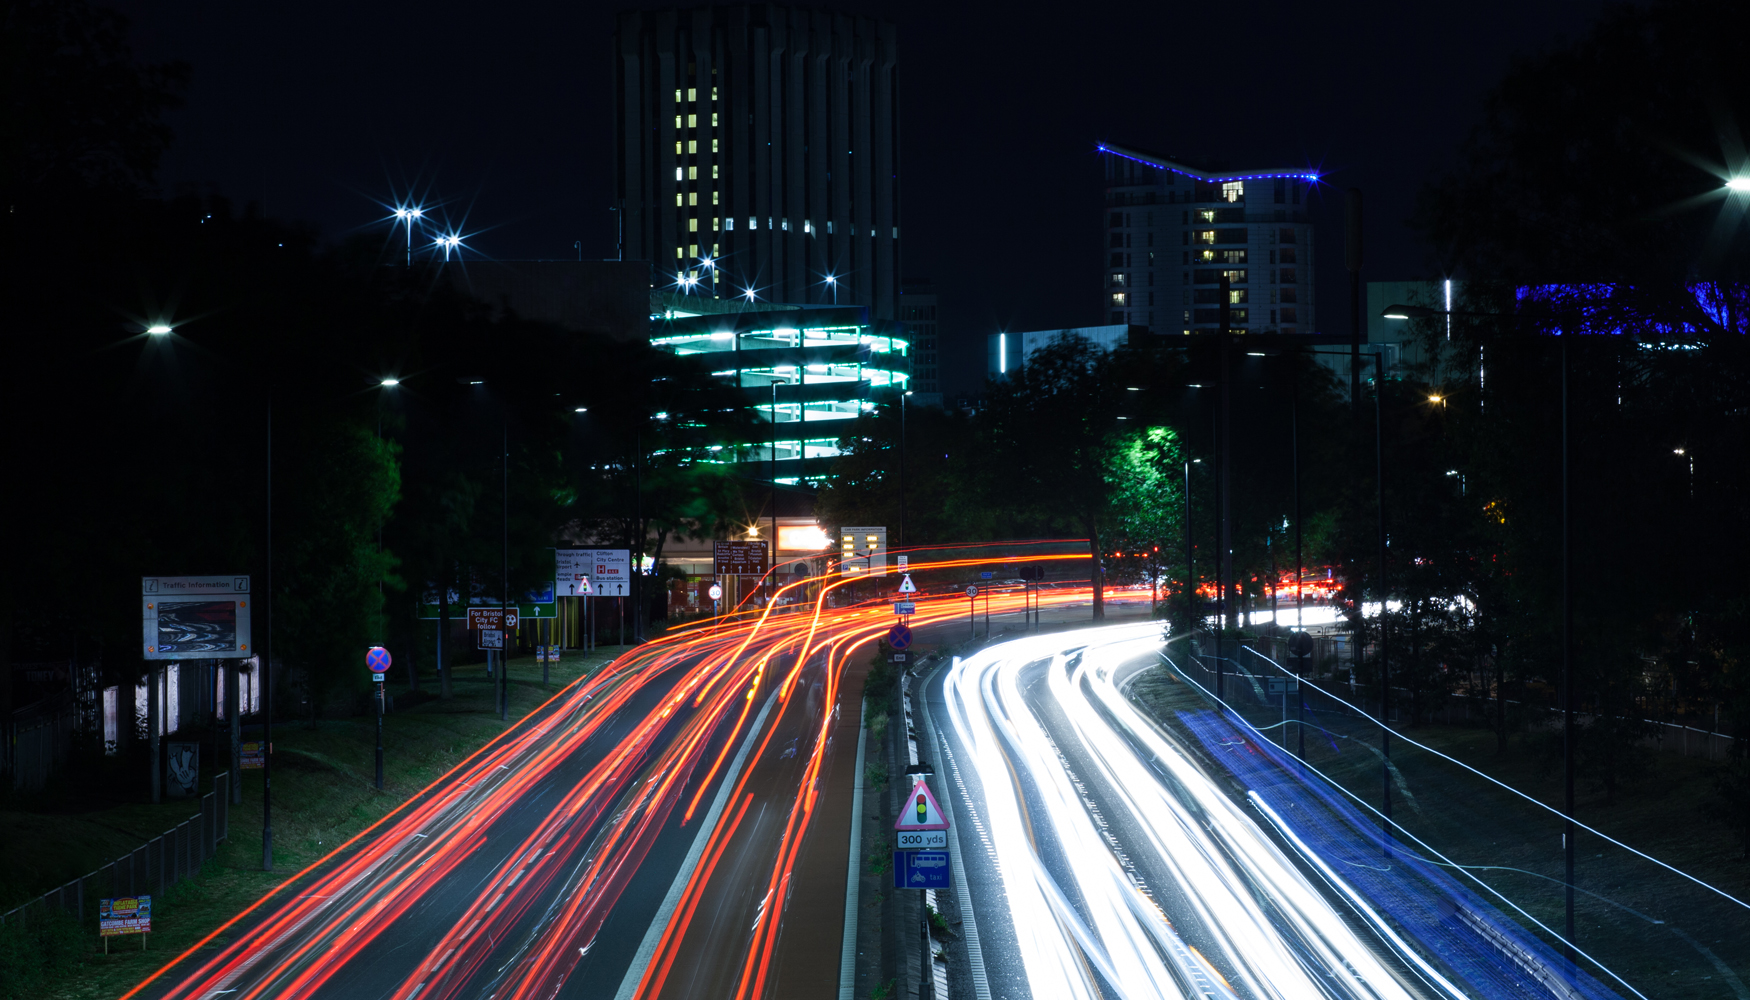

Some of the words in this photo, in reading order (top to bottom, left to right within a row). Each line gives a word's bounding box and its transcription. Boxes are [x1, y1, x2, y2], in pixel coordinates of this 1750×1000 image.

[26, 671, 54, 682] TONEY
[902, 835, 922, 844] 300
[926, 835, 944, 845] yds
